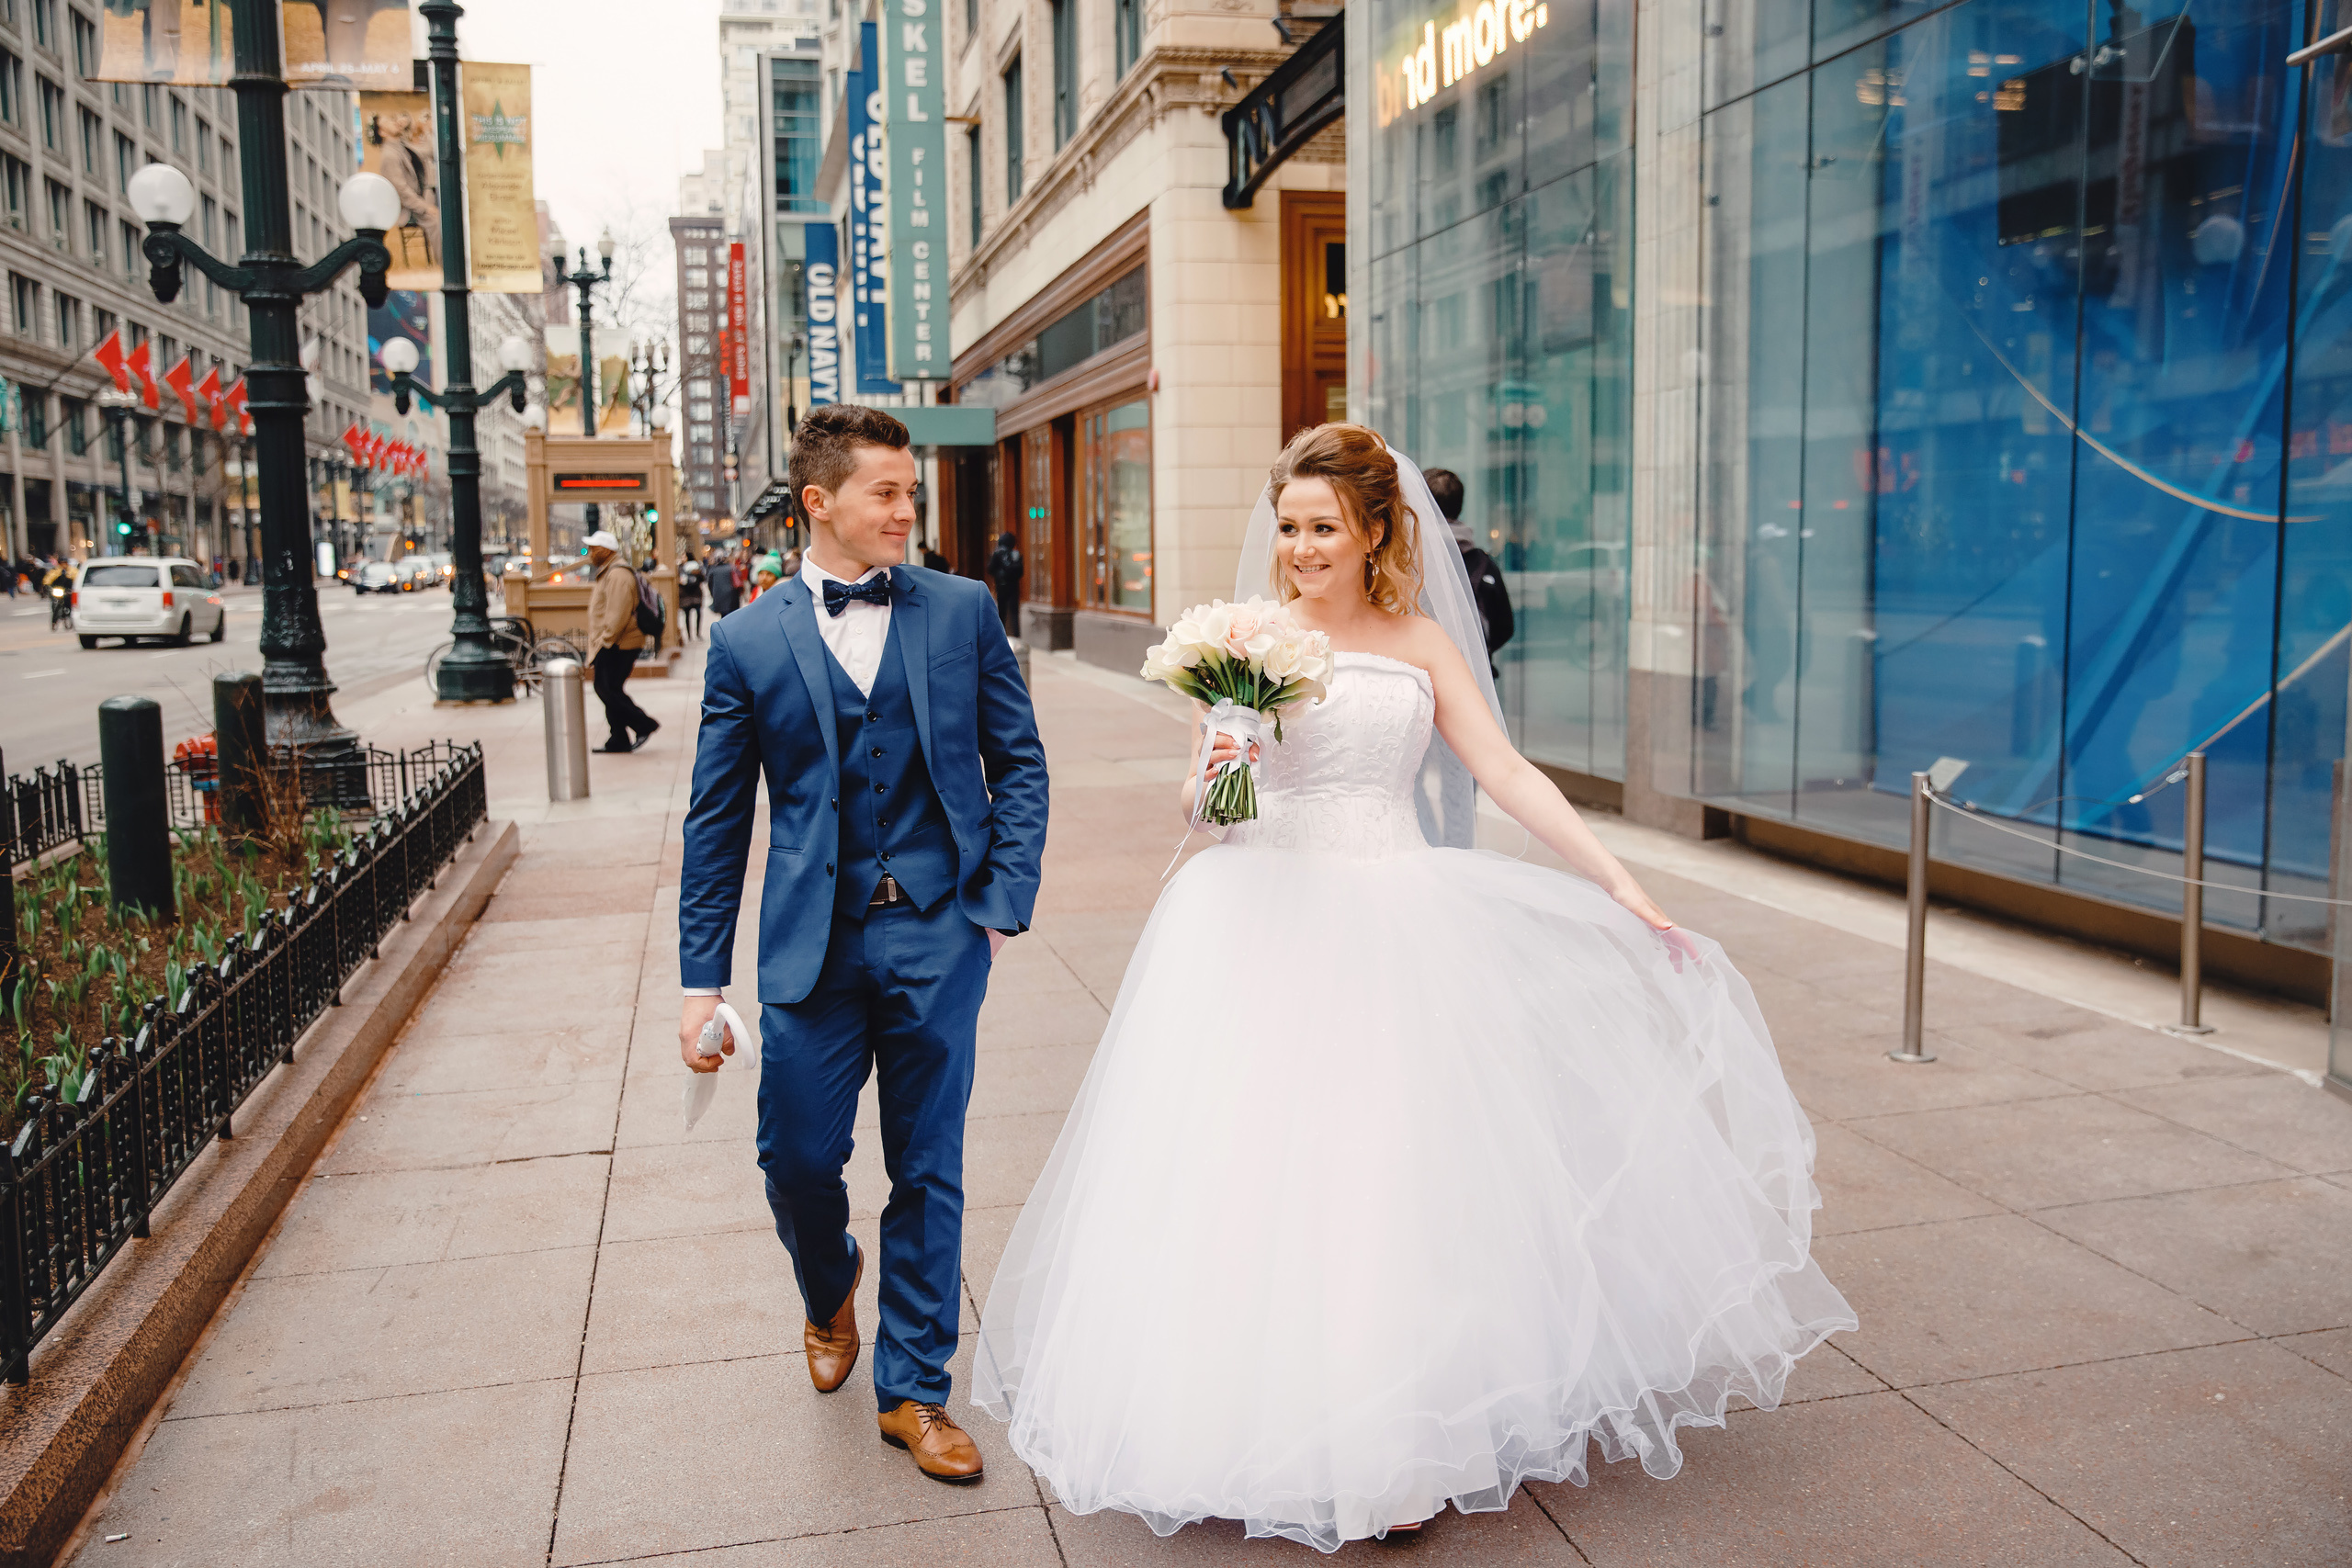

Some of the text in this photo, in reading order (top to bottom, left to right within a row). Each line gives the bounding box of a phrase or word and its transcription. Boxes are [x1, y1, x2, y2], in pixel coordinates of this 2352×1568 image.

[1441, 0, 1549, 88] more.
[910, 147, 929, 228] FILM
[807, 262, 840, 403] OLD NAVY
[911, 240, 932, 362] CENTER
